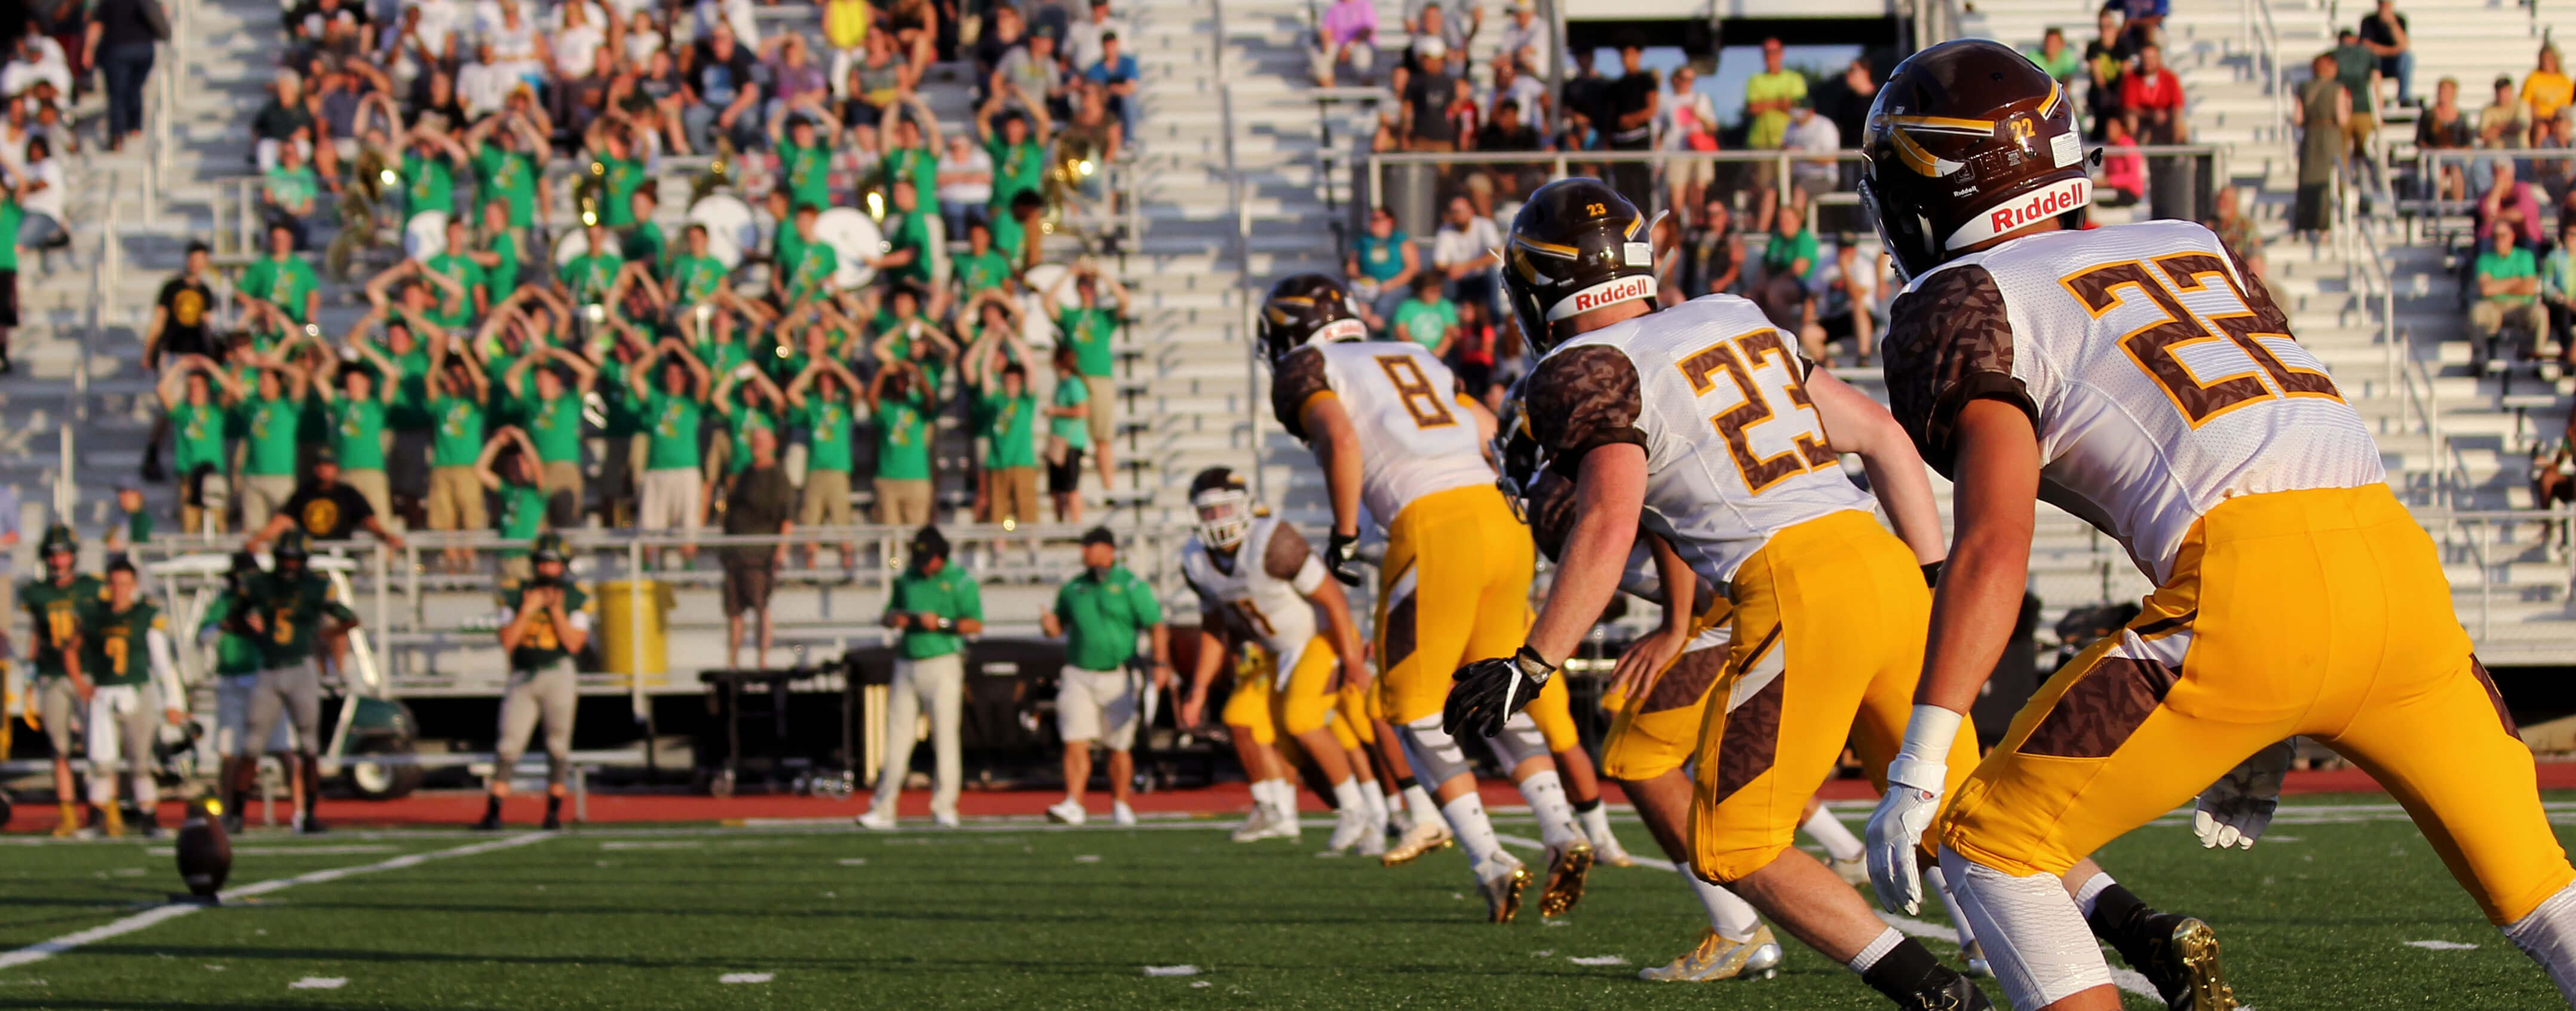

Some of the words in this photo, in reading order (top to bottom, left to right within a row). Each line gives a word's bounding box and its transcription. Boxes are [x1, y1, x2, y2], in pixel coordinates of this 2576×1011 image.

[2010, 118, 2035, 145] 22
[1586, 203, 1607, 216] 23
[1954, 186, 1977, 197] Riddell
[1991, 182, 2083, 233] Riddell
[1575, 278, 1648, 311] Riddell
[2058, 251, 2346, 430] 22
[1374, 354, 1458, 429] 8
[1675, 327, 1839, 497] 23
[274, 608, 293, 644] 5
